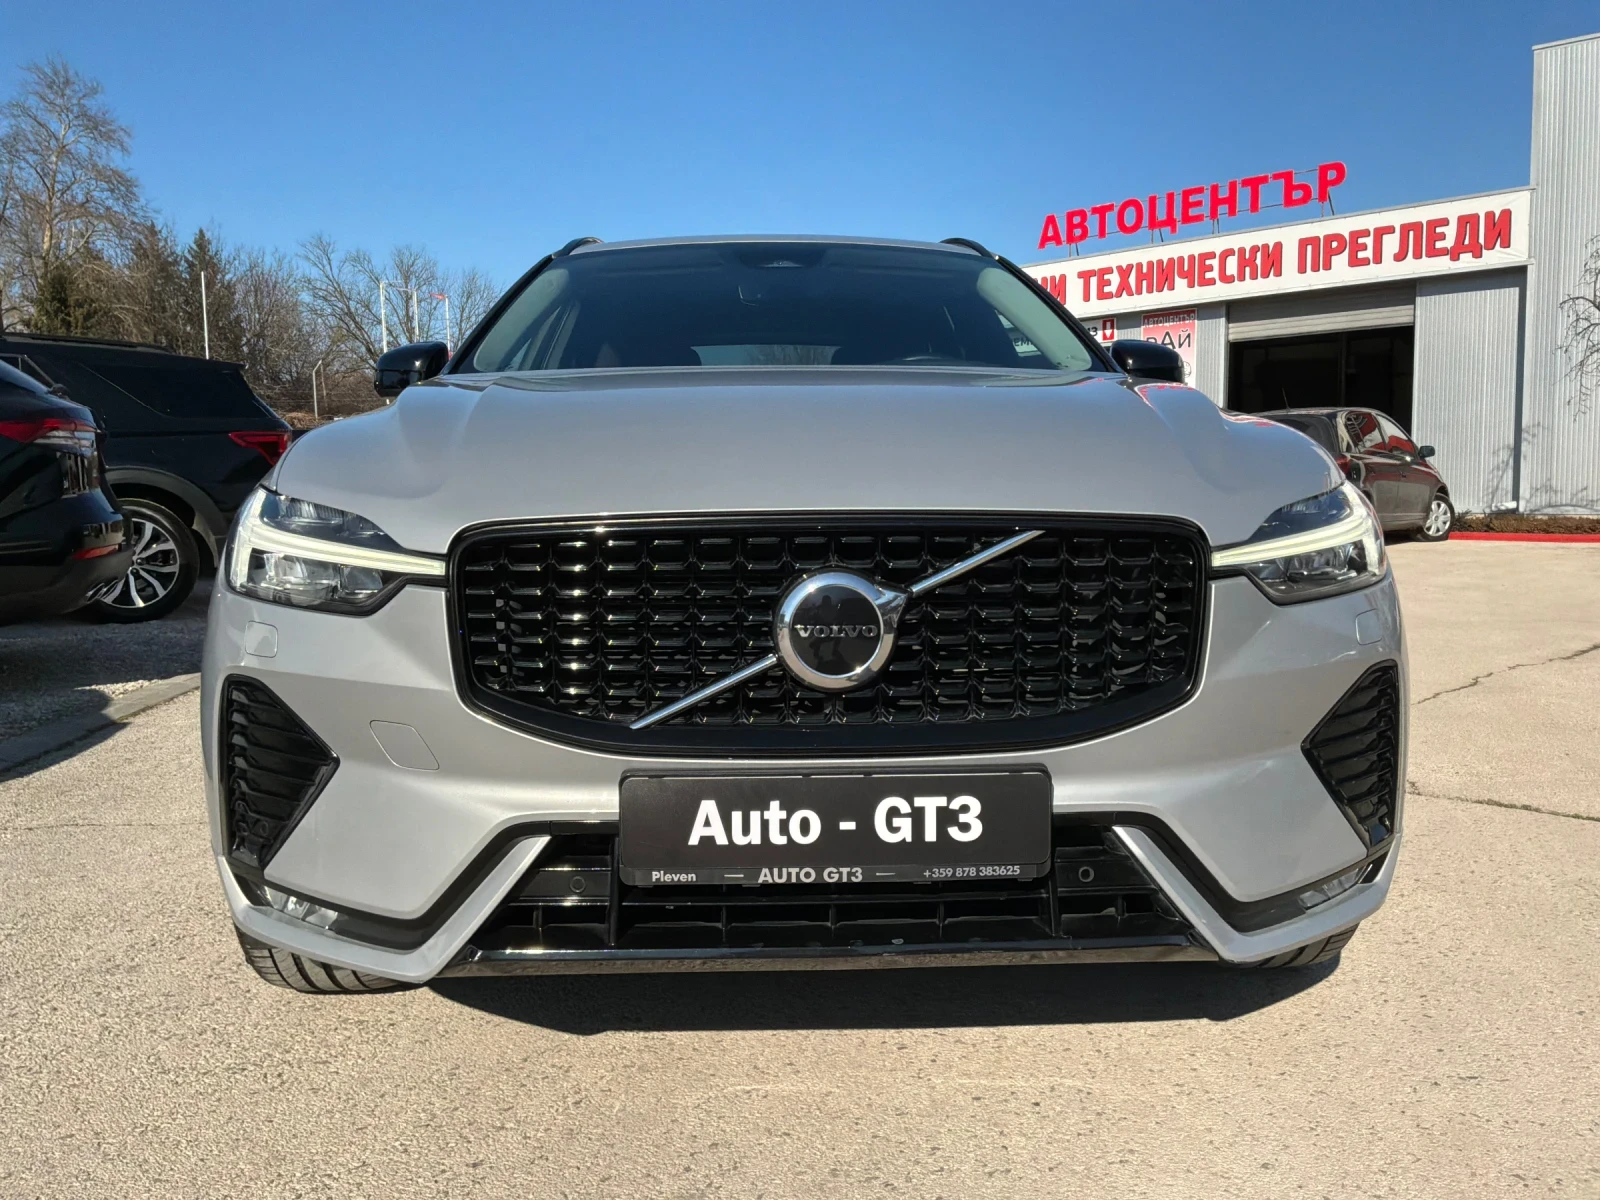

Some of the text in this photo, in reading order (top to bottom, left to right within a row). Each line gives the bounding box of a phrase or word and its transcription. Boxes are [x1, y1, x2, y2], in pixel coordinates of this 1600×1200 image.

[1037, 161, 1347, 249] АВТОЦЕНТЪР
[1077, 241, 1283, 302] ТЕХНИЧЕСКИ
[1297, 208, 1512, 274] ПРЕГЛЕДИ
[1143, 313, 1195, 328] АВТОЦЕНТЪР
[794, 624, 878, 638] VOLVO
[687, 799, 822, 846] Auto
[874, 795, 983, 843] GT3
[651, 865, 1021, 883] Pleven AUTO GT3 +359 878 383625
